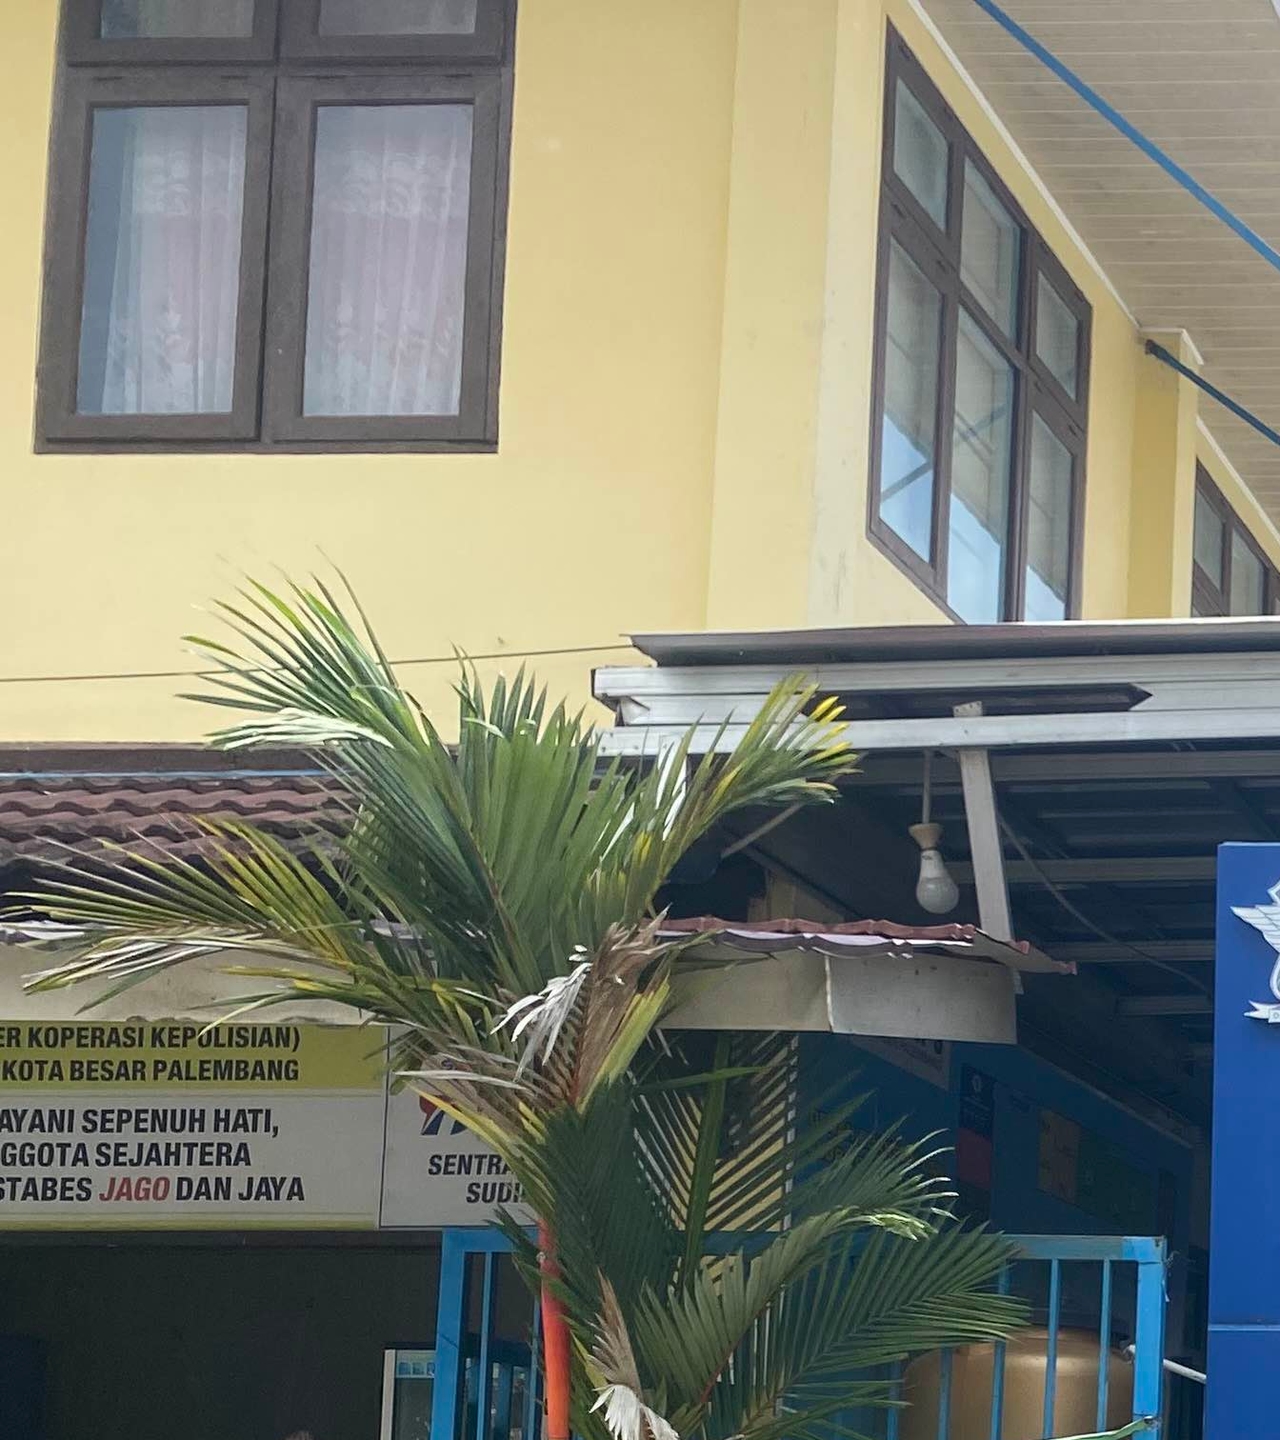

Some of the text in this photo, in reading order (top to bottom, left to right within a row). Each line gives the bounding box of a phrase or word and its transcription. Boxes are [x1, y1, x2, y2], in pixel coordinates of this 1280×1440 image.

[28, 1026, 144, 1049] KOPERASI
[151, 1026, 300, 1052] KEPOLISIAN)
[2, 1059, 299, 1081] KOTA BESAR PALEMBANG
[0, 1108, 279, 1138] AYANI SEPENUH HATI,
[1, 1142, 252, 1167] GGOTA SEJAHTERA
[98, 1176, 171, 1202] JAGO
[176, 1176, 232, 1201] DAN
[238, 1176, 305, 1202] JAYA
